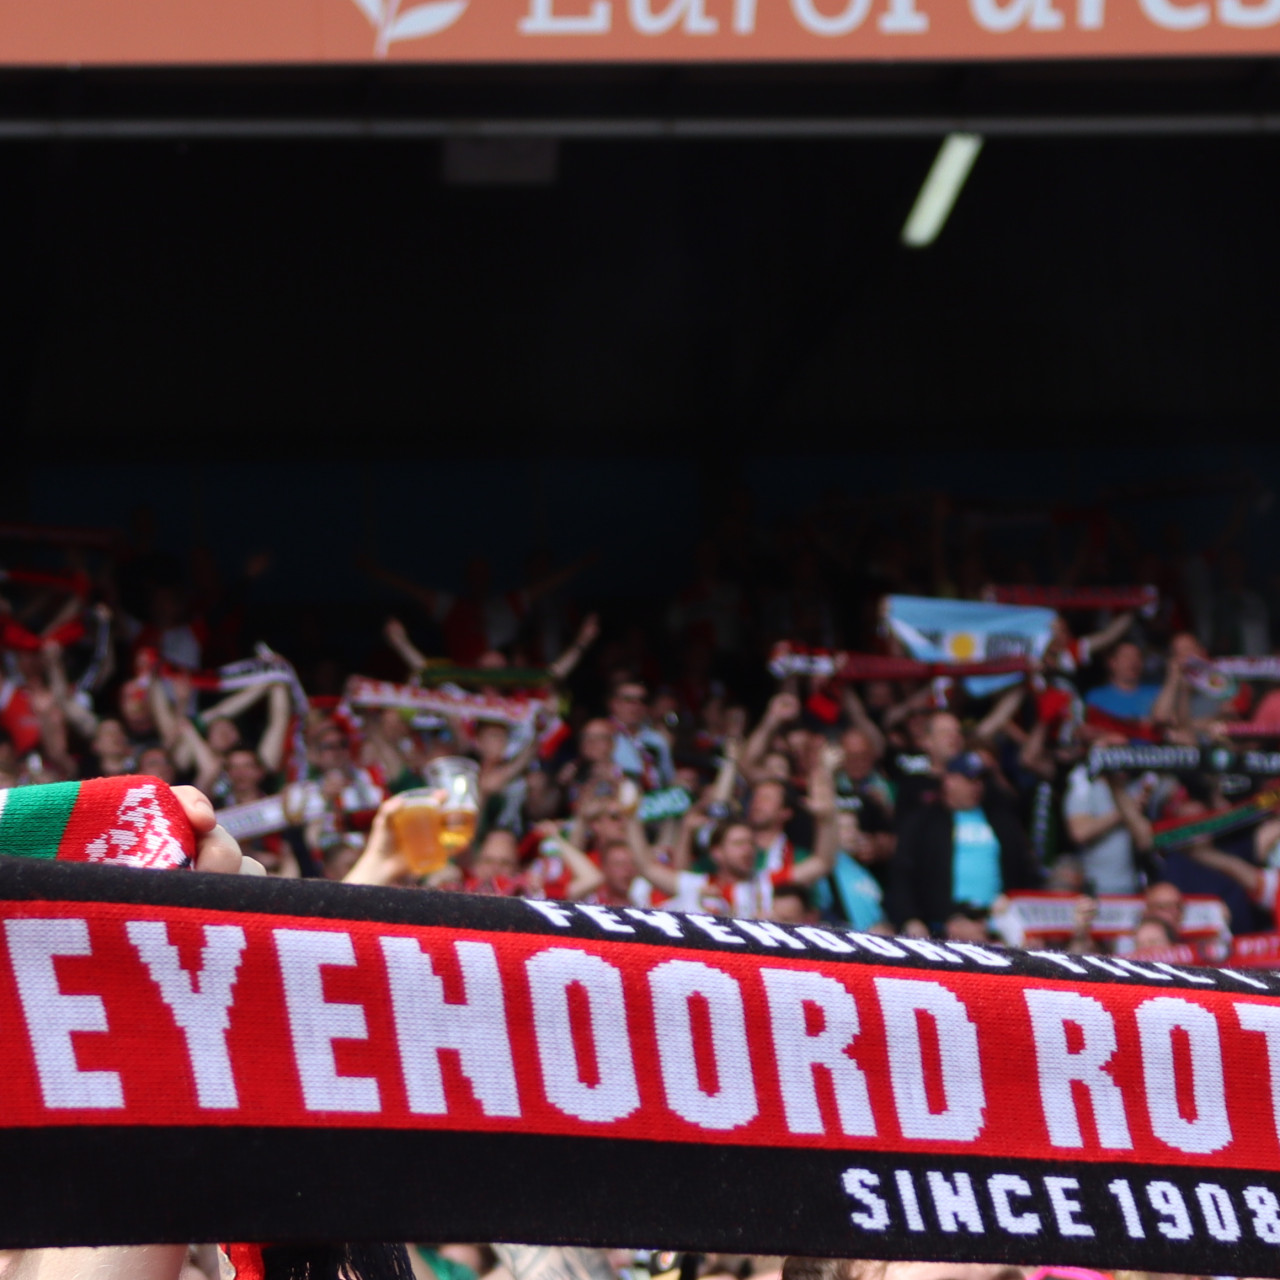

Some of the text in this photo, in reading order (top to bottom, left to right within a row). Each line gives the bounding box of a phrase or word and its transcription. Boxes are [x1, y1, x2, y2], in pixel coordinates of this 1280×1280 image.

[526, 899, 1012, 967] FEYENOORD
[1027, 951, 1216, 984] TILL
[841, 1168, 1095, 1237] SINCE
